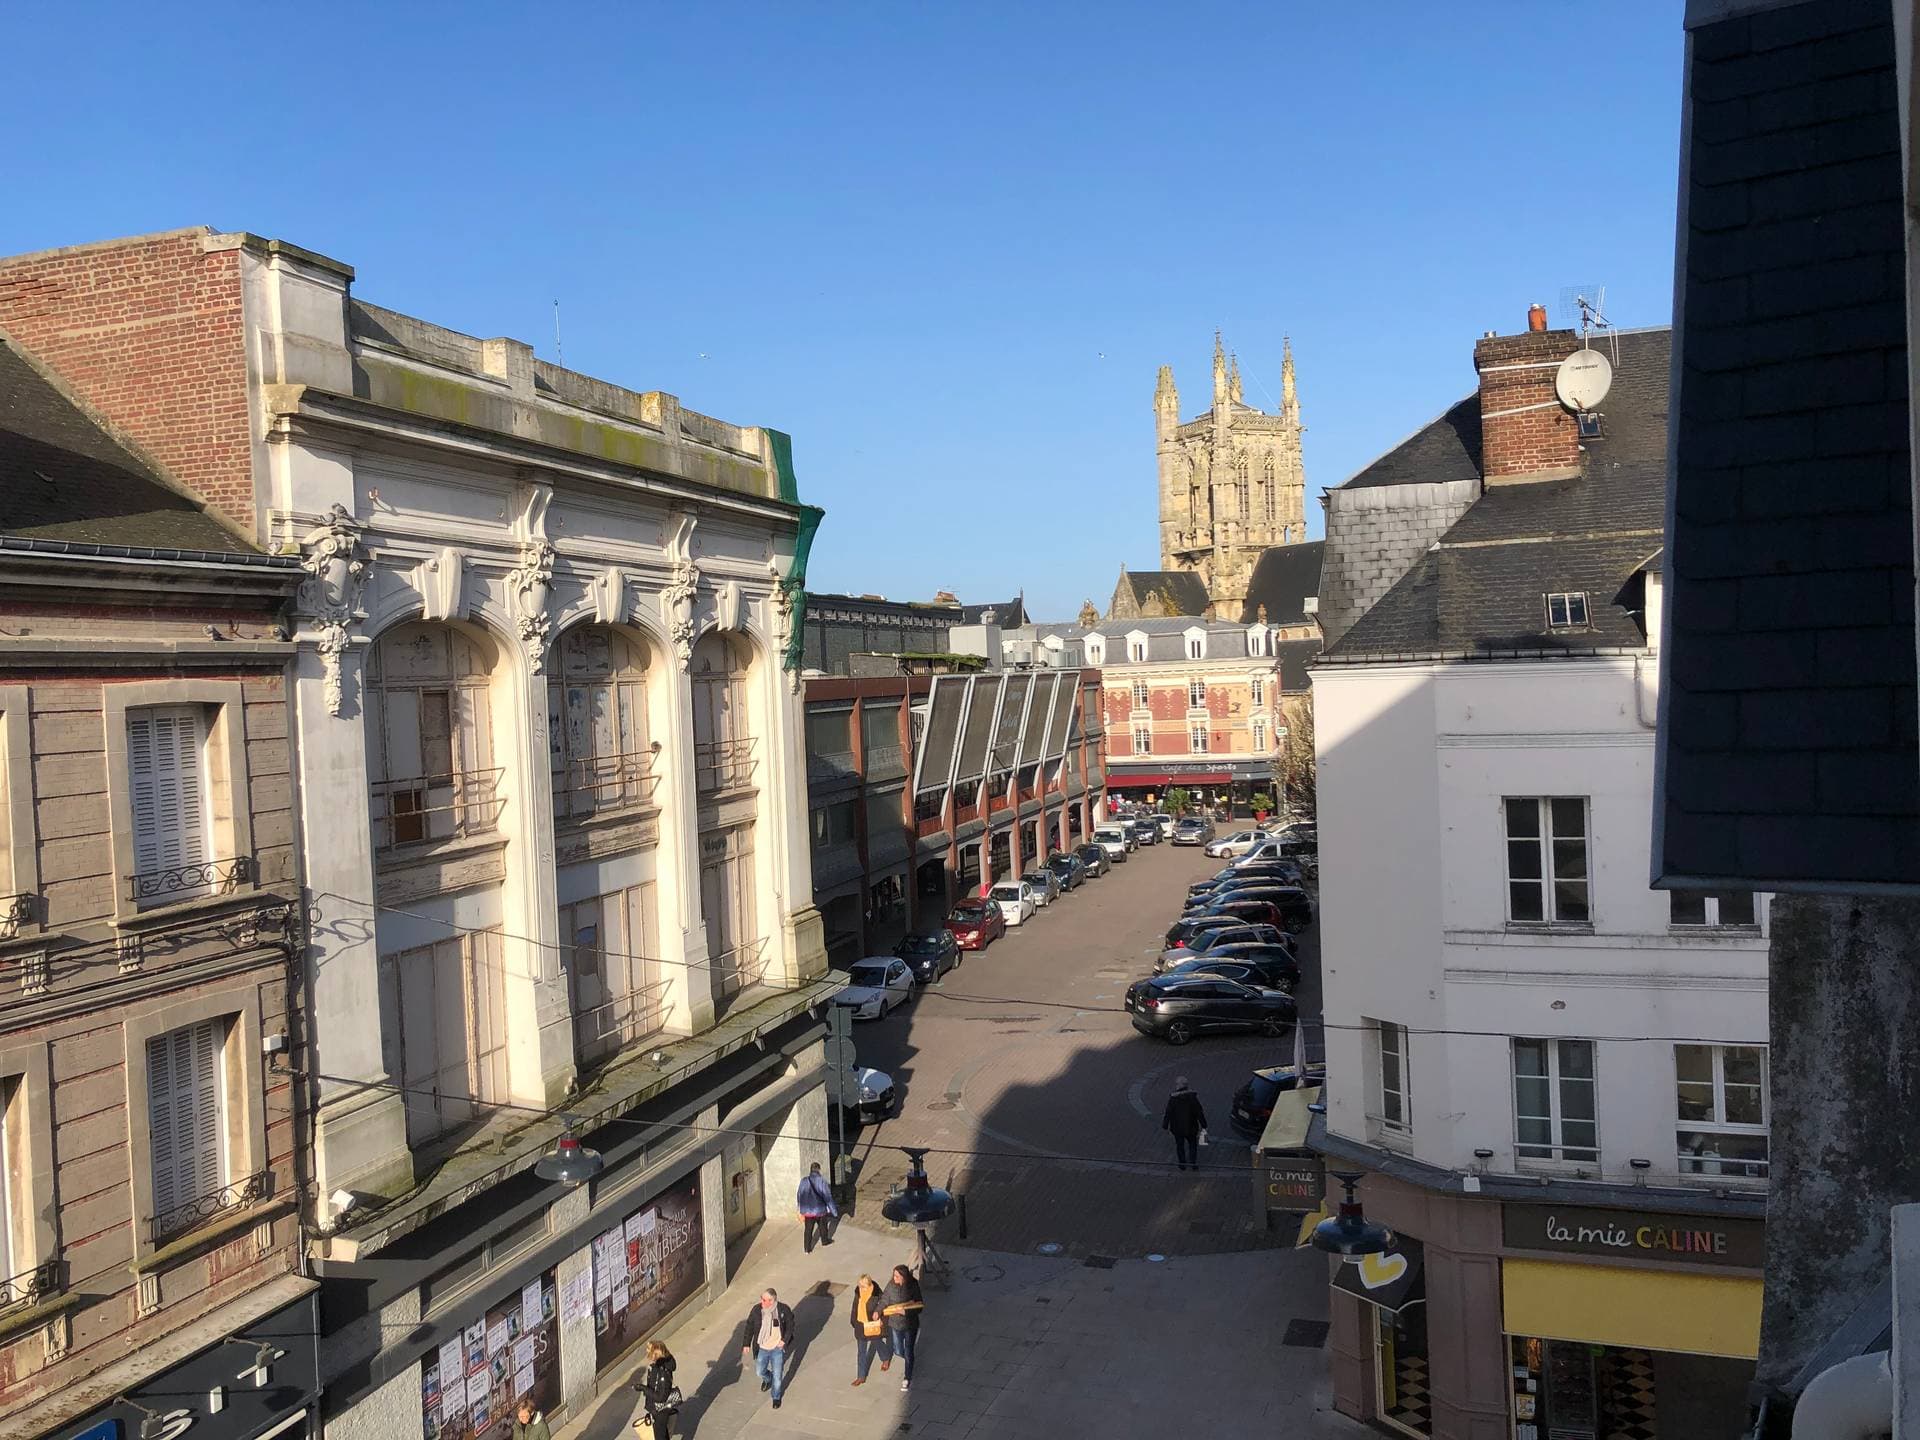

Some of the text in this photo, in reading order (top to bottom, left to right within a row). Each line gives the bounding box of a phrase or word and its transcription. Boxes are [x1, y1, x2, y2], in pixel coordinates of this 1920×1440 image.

[1269, 1166, 1315, 1182] la mie
[1546, 1215, 1574, 1241] la
[1577, 1222, 1632, 1247] mie
